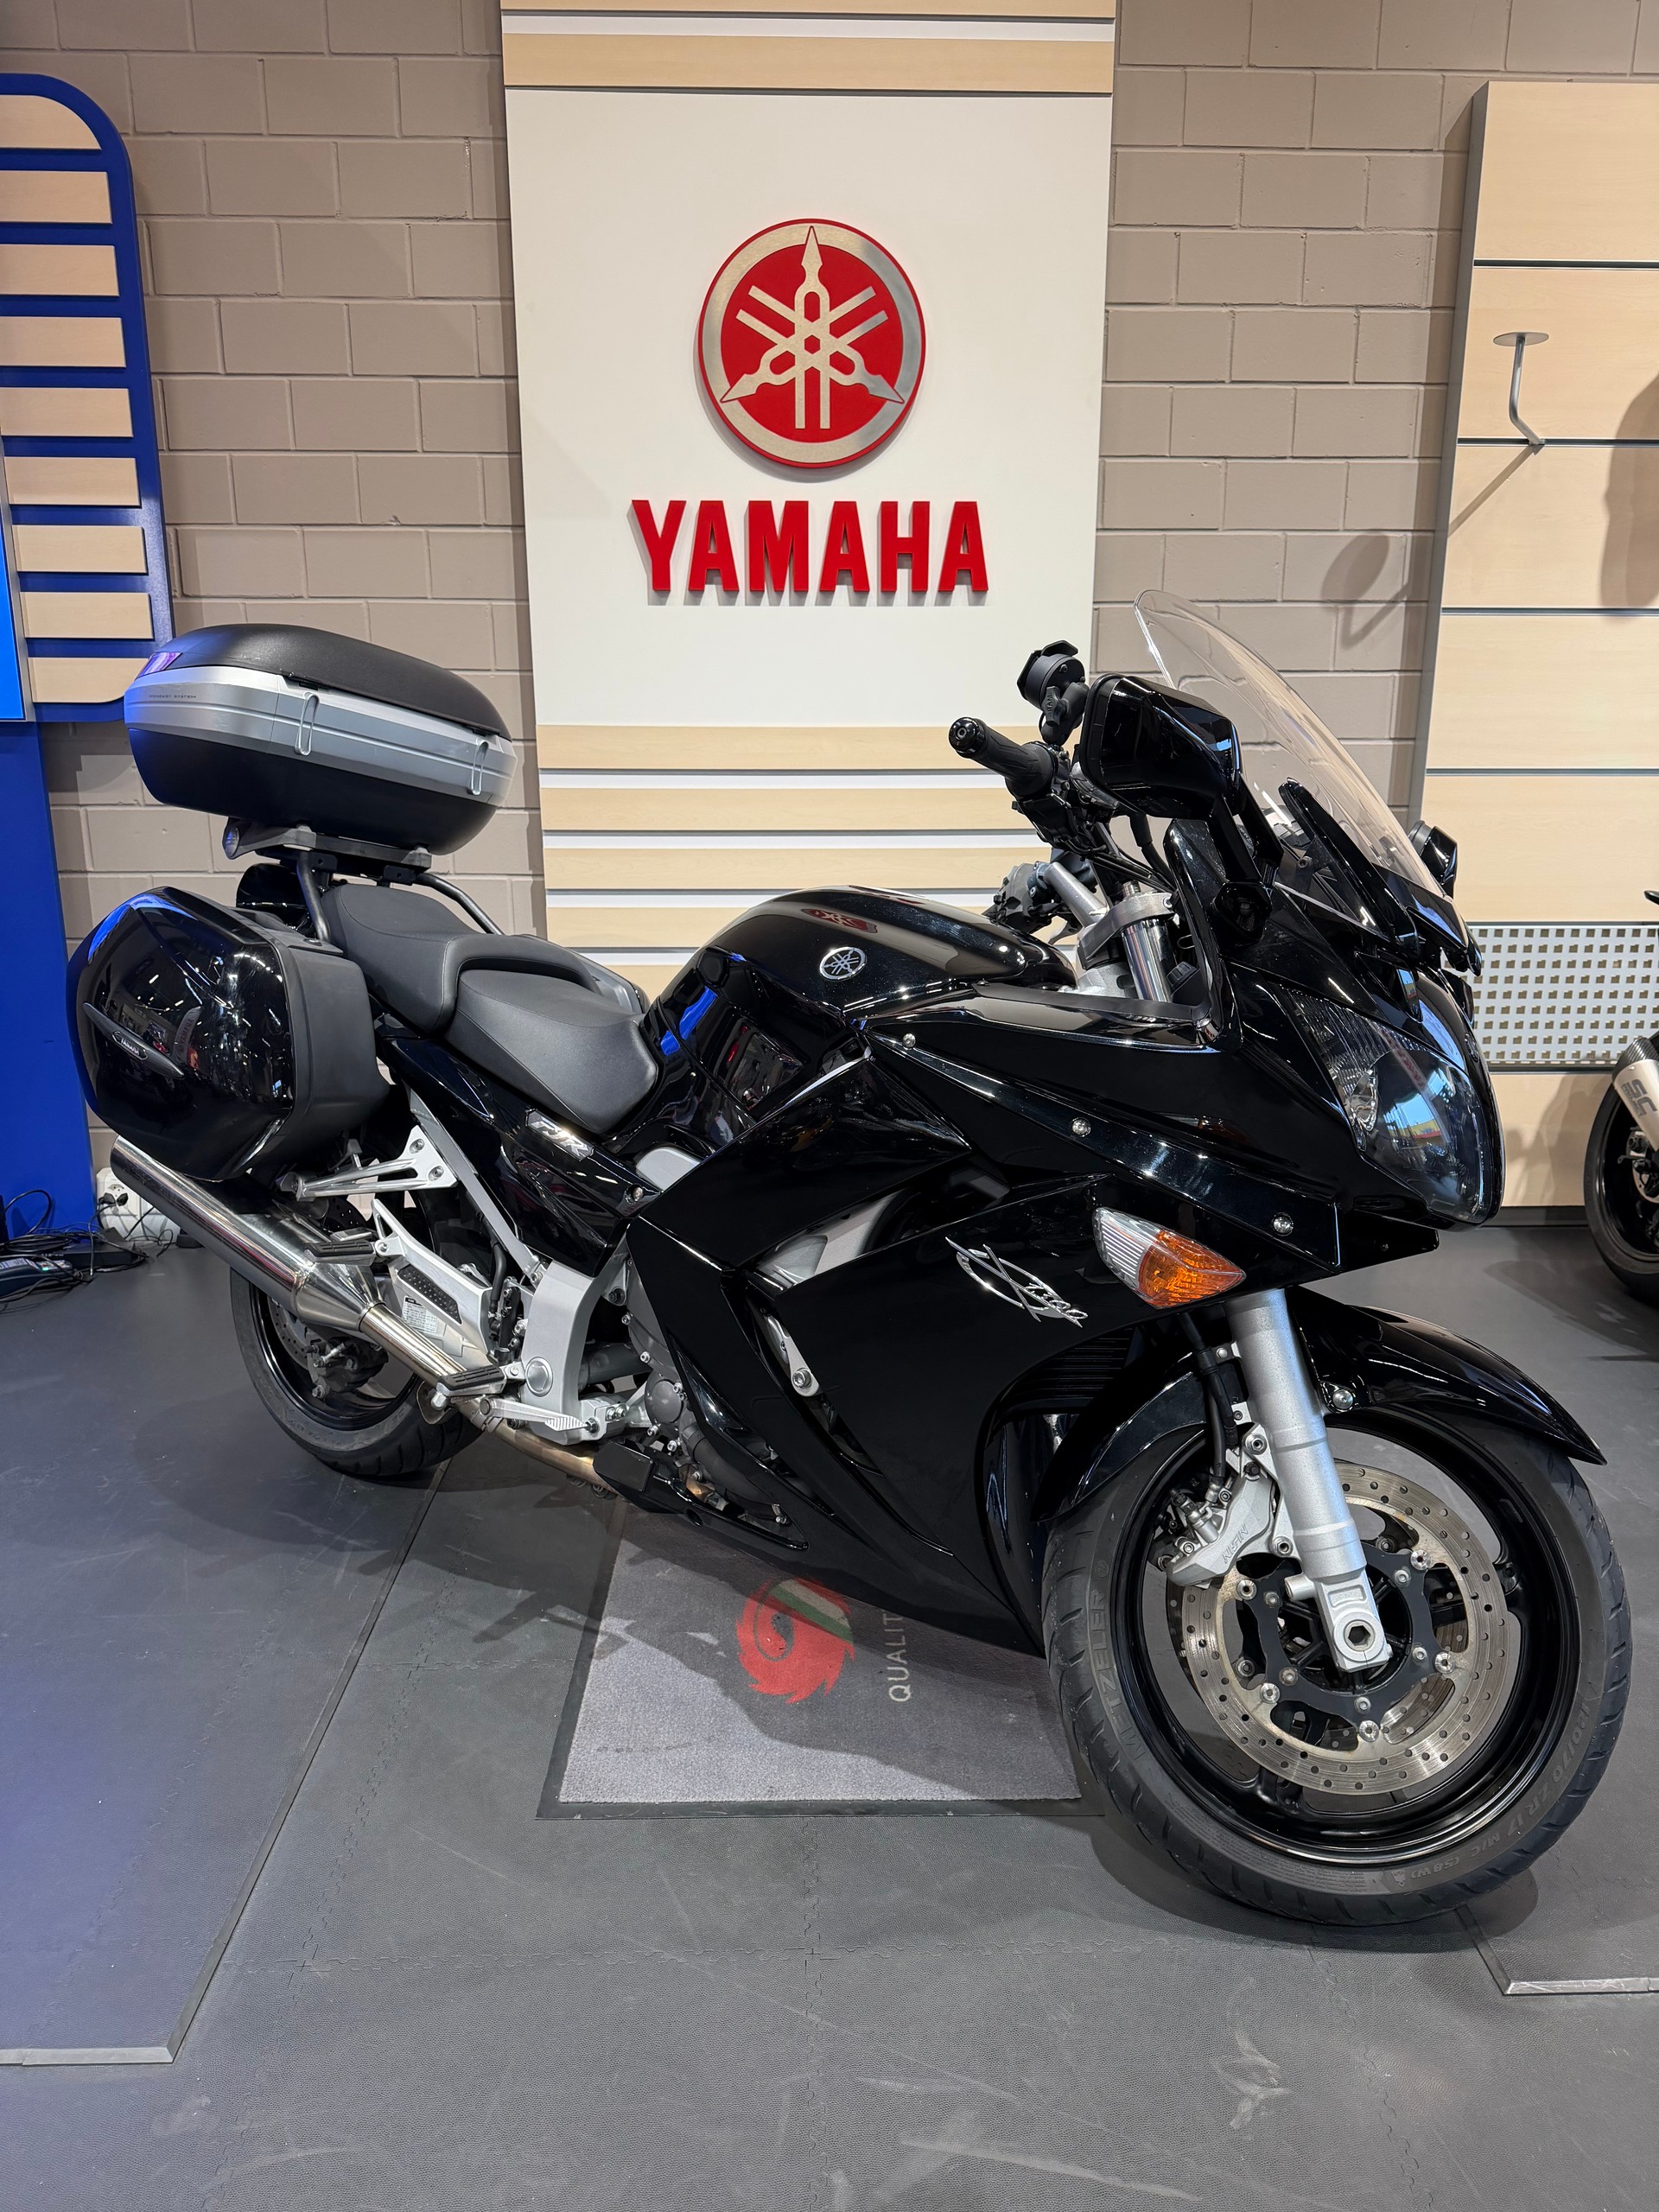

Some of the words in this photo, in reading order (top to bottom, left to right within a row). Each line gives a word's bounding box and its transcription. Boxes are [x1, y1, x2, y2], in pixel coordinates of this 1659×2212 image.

[632, 499, 989, 592] YAMAHA
[531, 1116, 589, 1157] FJR
[882, 1611, 912, 1702] QUALIT
[1091, 1590, 1147, 1761] METZELER
[1507, 1811, 1524, 1834] 17
[1526, 1783, 1548, 1815] ZR
